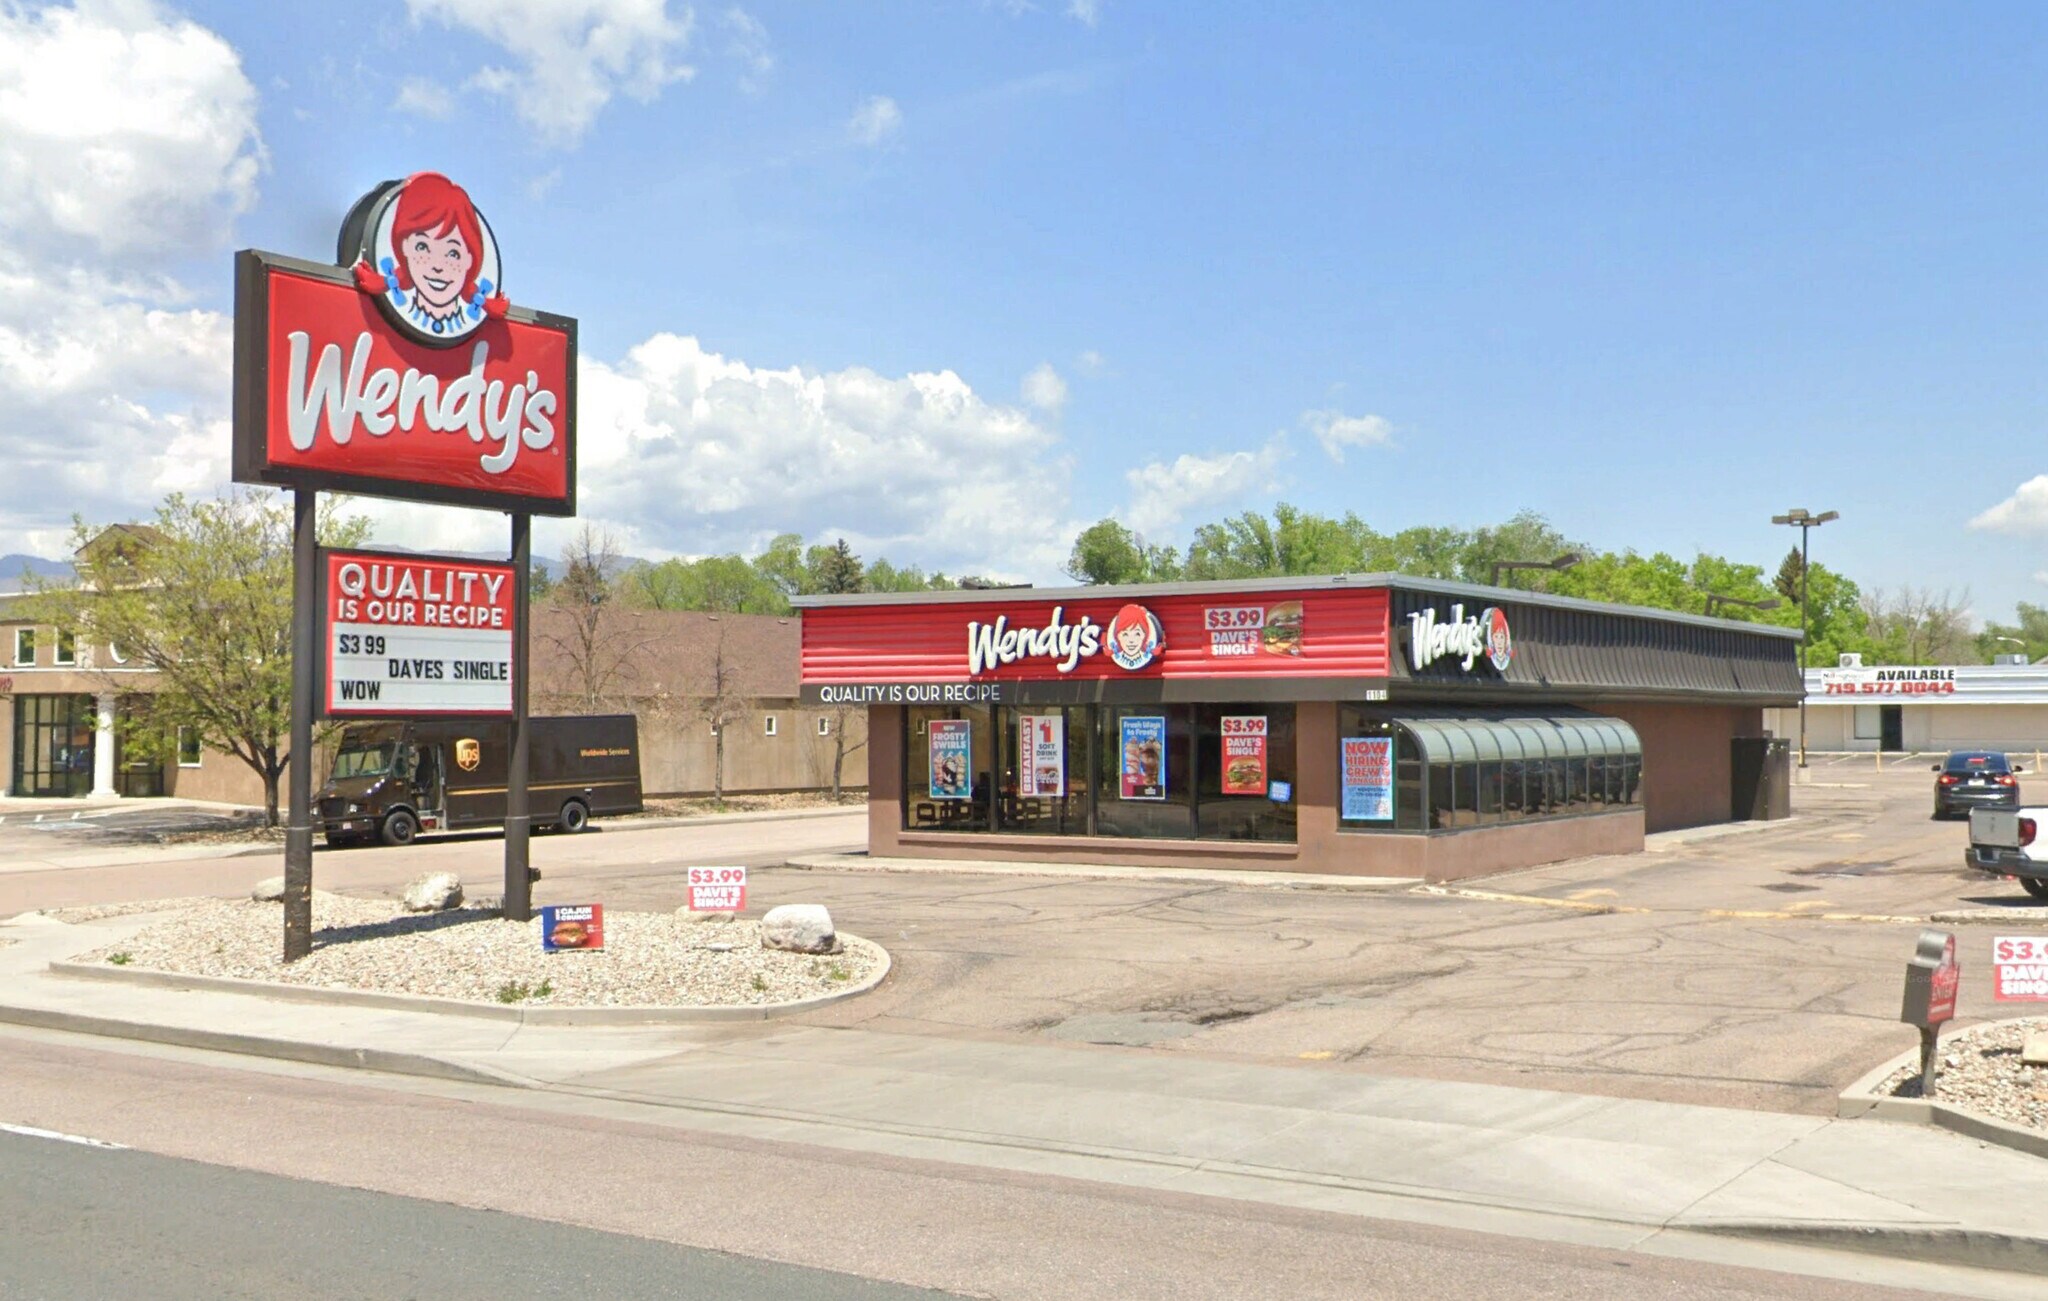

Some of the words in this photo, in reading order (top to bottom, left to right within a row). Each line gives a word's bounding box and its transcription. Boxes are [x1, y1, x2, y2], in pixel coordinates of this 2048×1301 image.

[287, 331, 557, 474] Wendy's
[338, 563, 505, 605] QUALITY
[338, 599, 358, 619] IS
[367, 601, 416, 623] OUR
[424, 604, 504, 626] RECIPE
[1208, 609, 1260, 628] $3.99
[967, 606, 1101, 675] Wendy's
[1211, 631, 1258, 644] DAVE'S
[1407, 603, 1484, 672] Wendy's
[1211, 644, 1256, 656] SINGLE
[389, 658, 443, 679] DAVES
[453, 661, 508, 680] SINGLE
[1877, 670, 1955, 680] AVAILABLE
[341, 680, 381, 700] WOW
[820, 685, 885, 703] QUALITY
[889, 685, 902, 701] IS
[906, 685, 940, 701] OUR
[944, 684, 1001, 701] RECIPE
[1824, 682, 1955, 694] 719.577.0044
[1223, 719, 1265, 732] $3.99
[932, 732, 966, 740] FROSTY
[1226, 737, 1262, 746] DAVE'S
[932, 741, 967, 749] SWIRLS
[1345, 742, 1389, 754] NOW
[1022, 717, 1032, 792] BREAKFAST
[1226, 747, 1261, 756] SINGLE
[1346, 756, 1389, 767] HIRING
[1346, 767, 1380, 777] CREW
[690, 869, 743, 884] $3.99
[693, 886, 740, 898] DAVE'S
[693, 897, 739, 908] SINGLE
[560, 907, 592, 915] CAJUN
